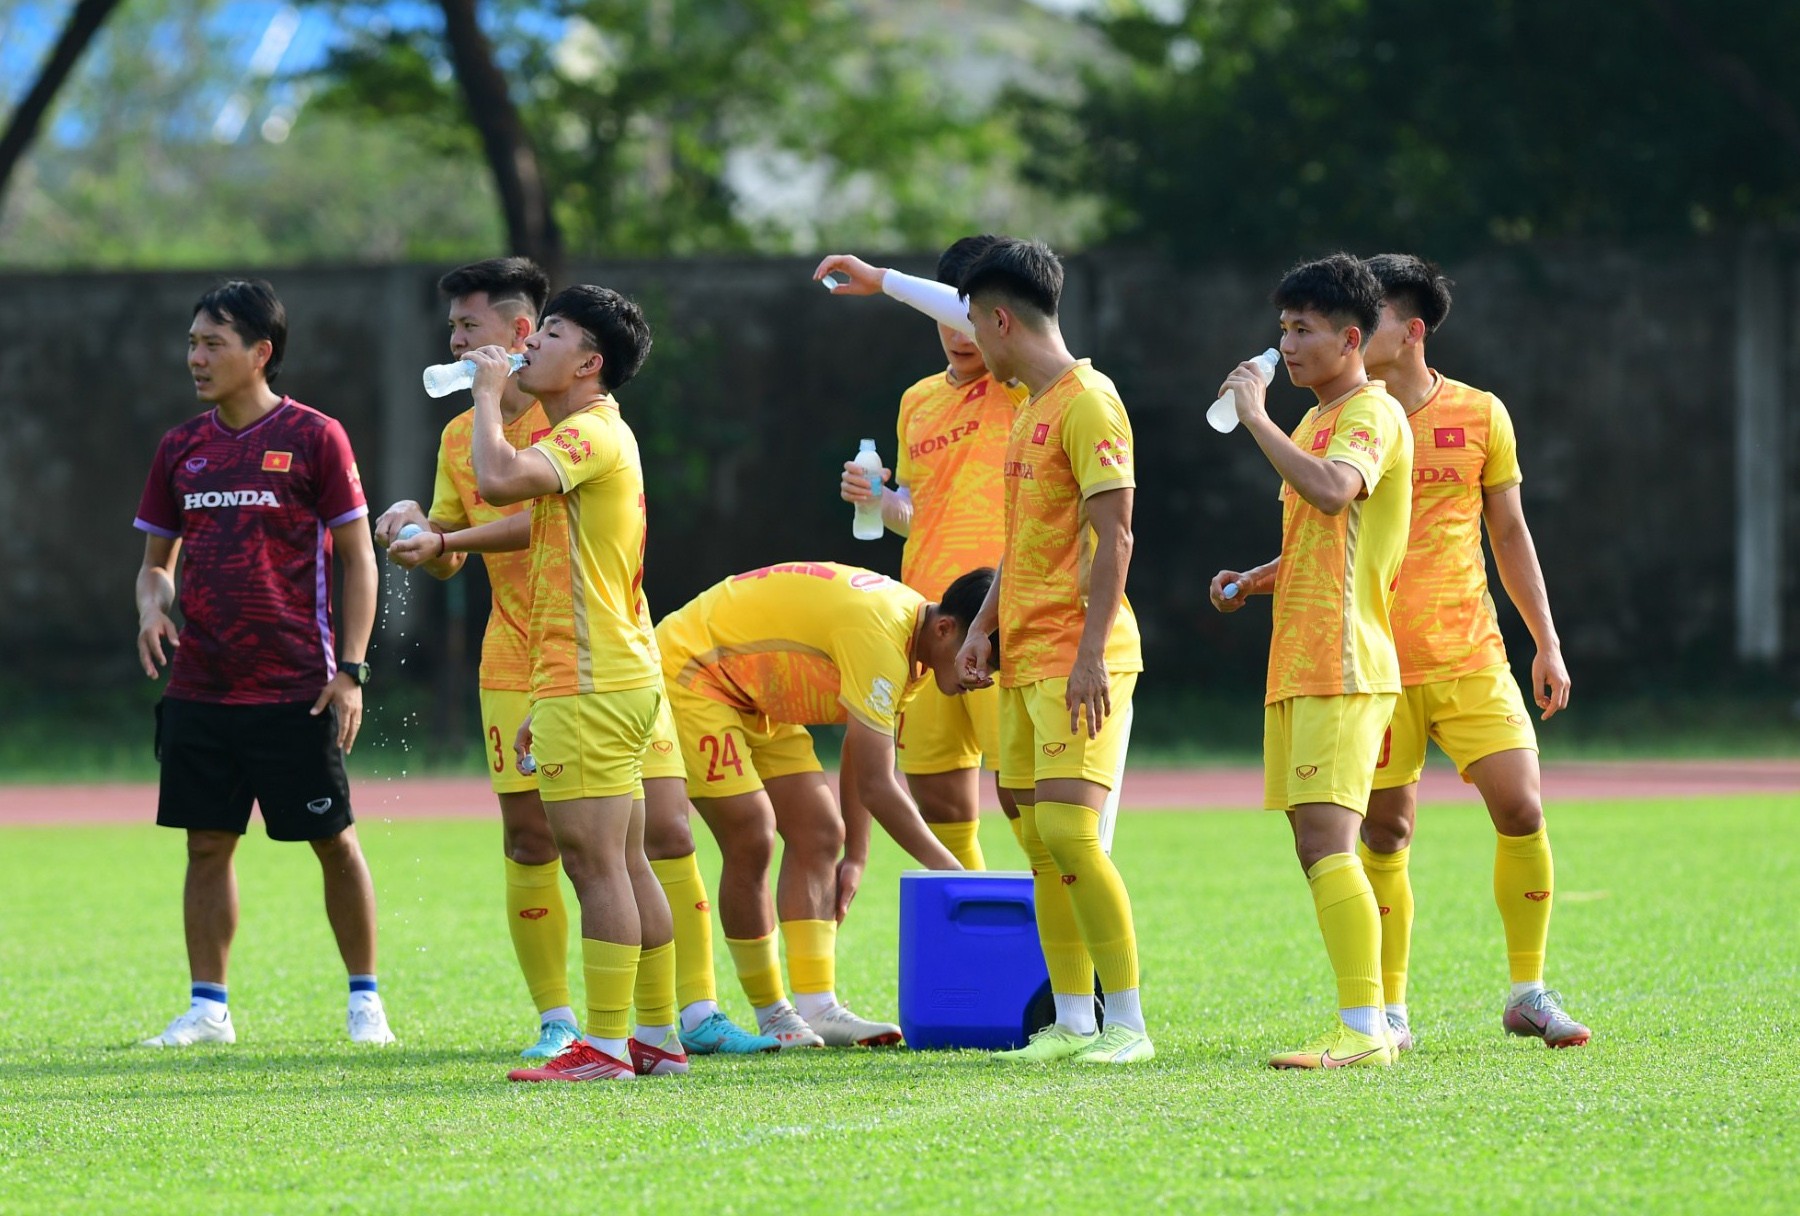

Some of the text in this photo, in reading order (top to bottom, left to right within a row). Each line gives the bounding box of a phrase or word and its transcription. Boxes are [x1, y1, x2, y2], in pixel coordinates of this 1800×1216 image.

[553, 434, 582, 465] Red Bull
[1100, 455, 1115, 467] Re
[184, 490, 280, 510] HONDA
[489, 726, 504, 773] 3
[700, 733, 744, 782] 24
